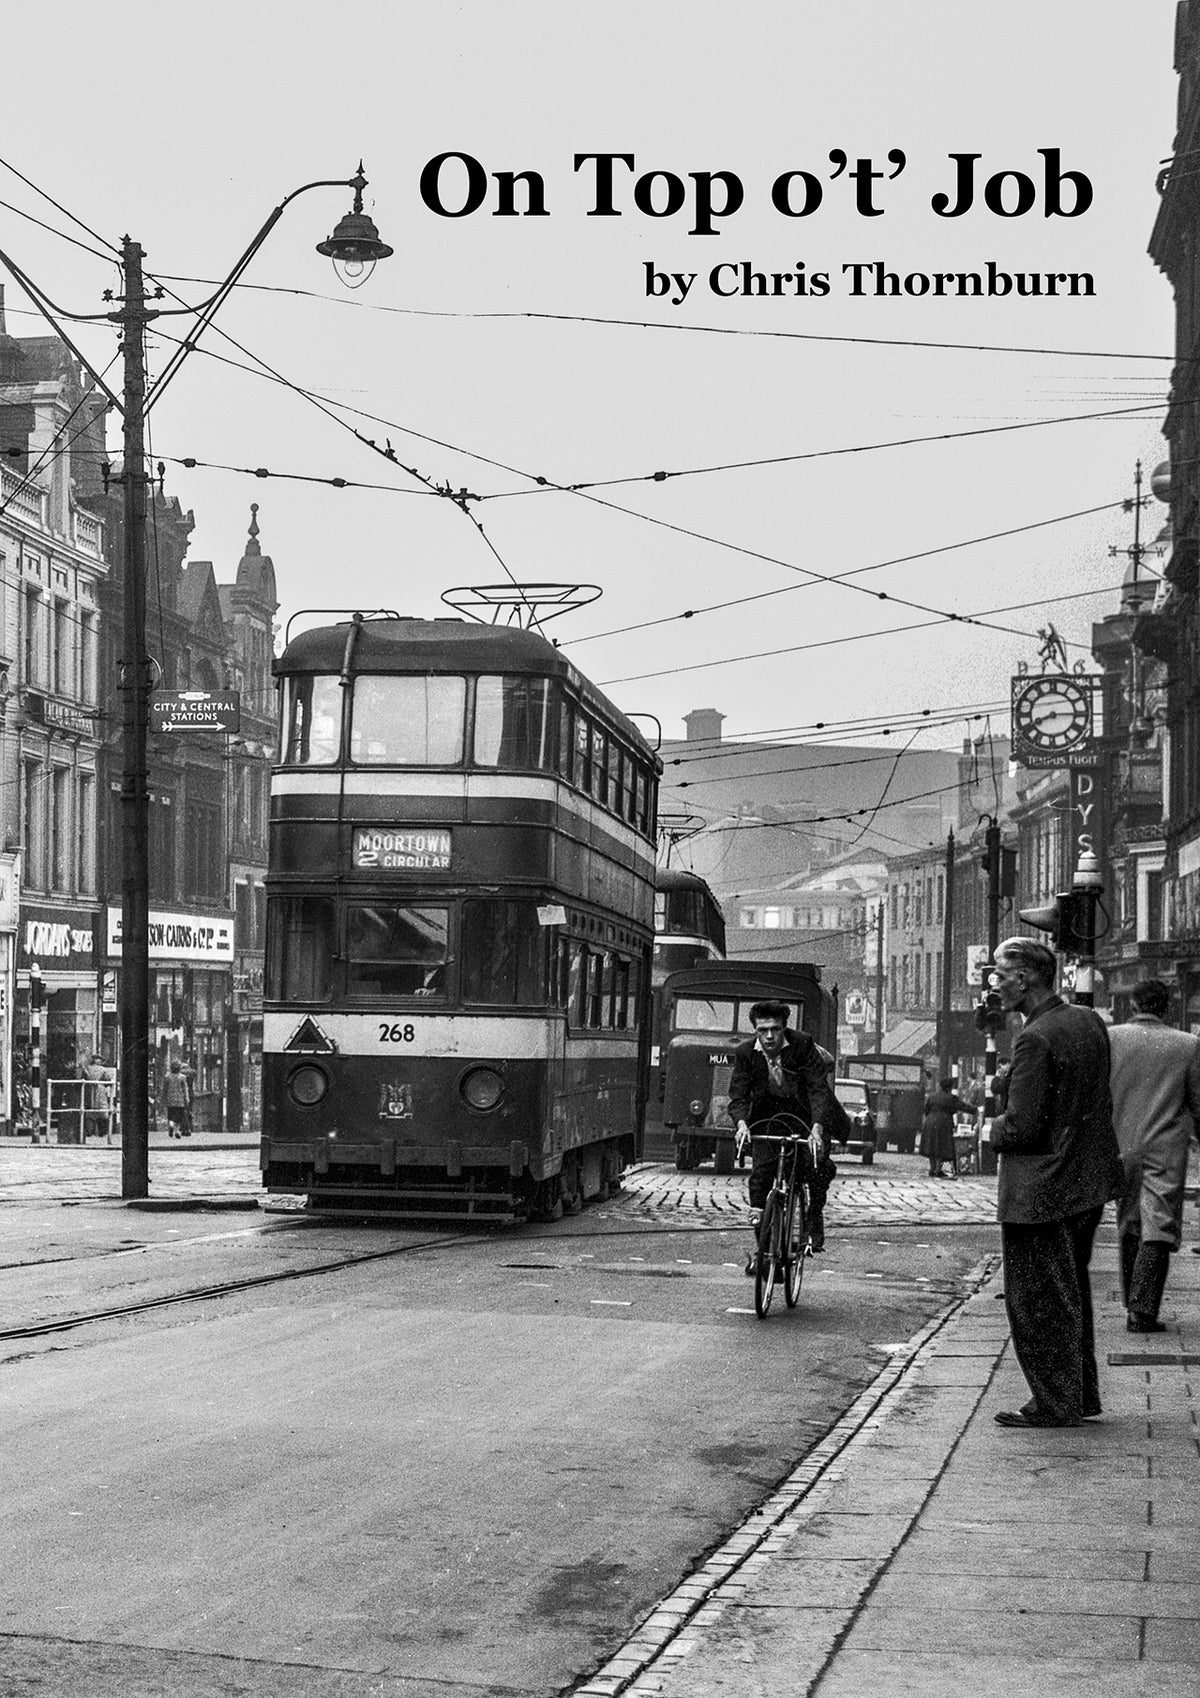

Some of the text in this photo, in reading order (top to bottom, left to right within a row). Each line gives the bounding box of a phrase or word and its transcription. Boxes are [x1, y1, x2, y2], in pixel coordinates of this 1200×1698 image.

[153, 702, 235, 711] CITY & CENTRAL
[170, 712, 218, 721] STATIONS
[358, 834, 451, 852] MOORTOWN
[358, 850, 450, 868] 2 CIRCULAR
[378, 1023, 415, 1042] 268
